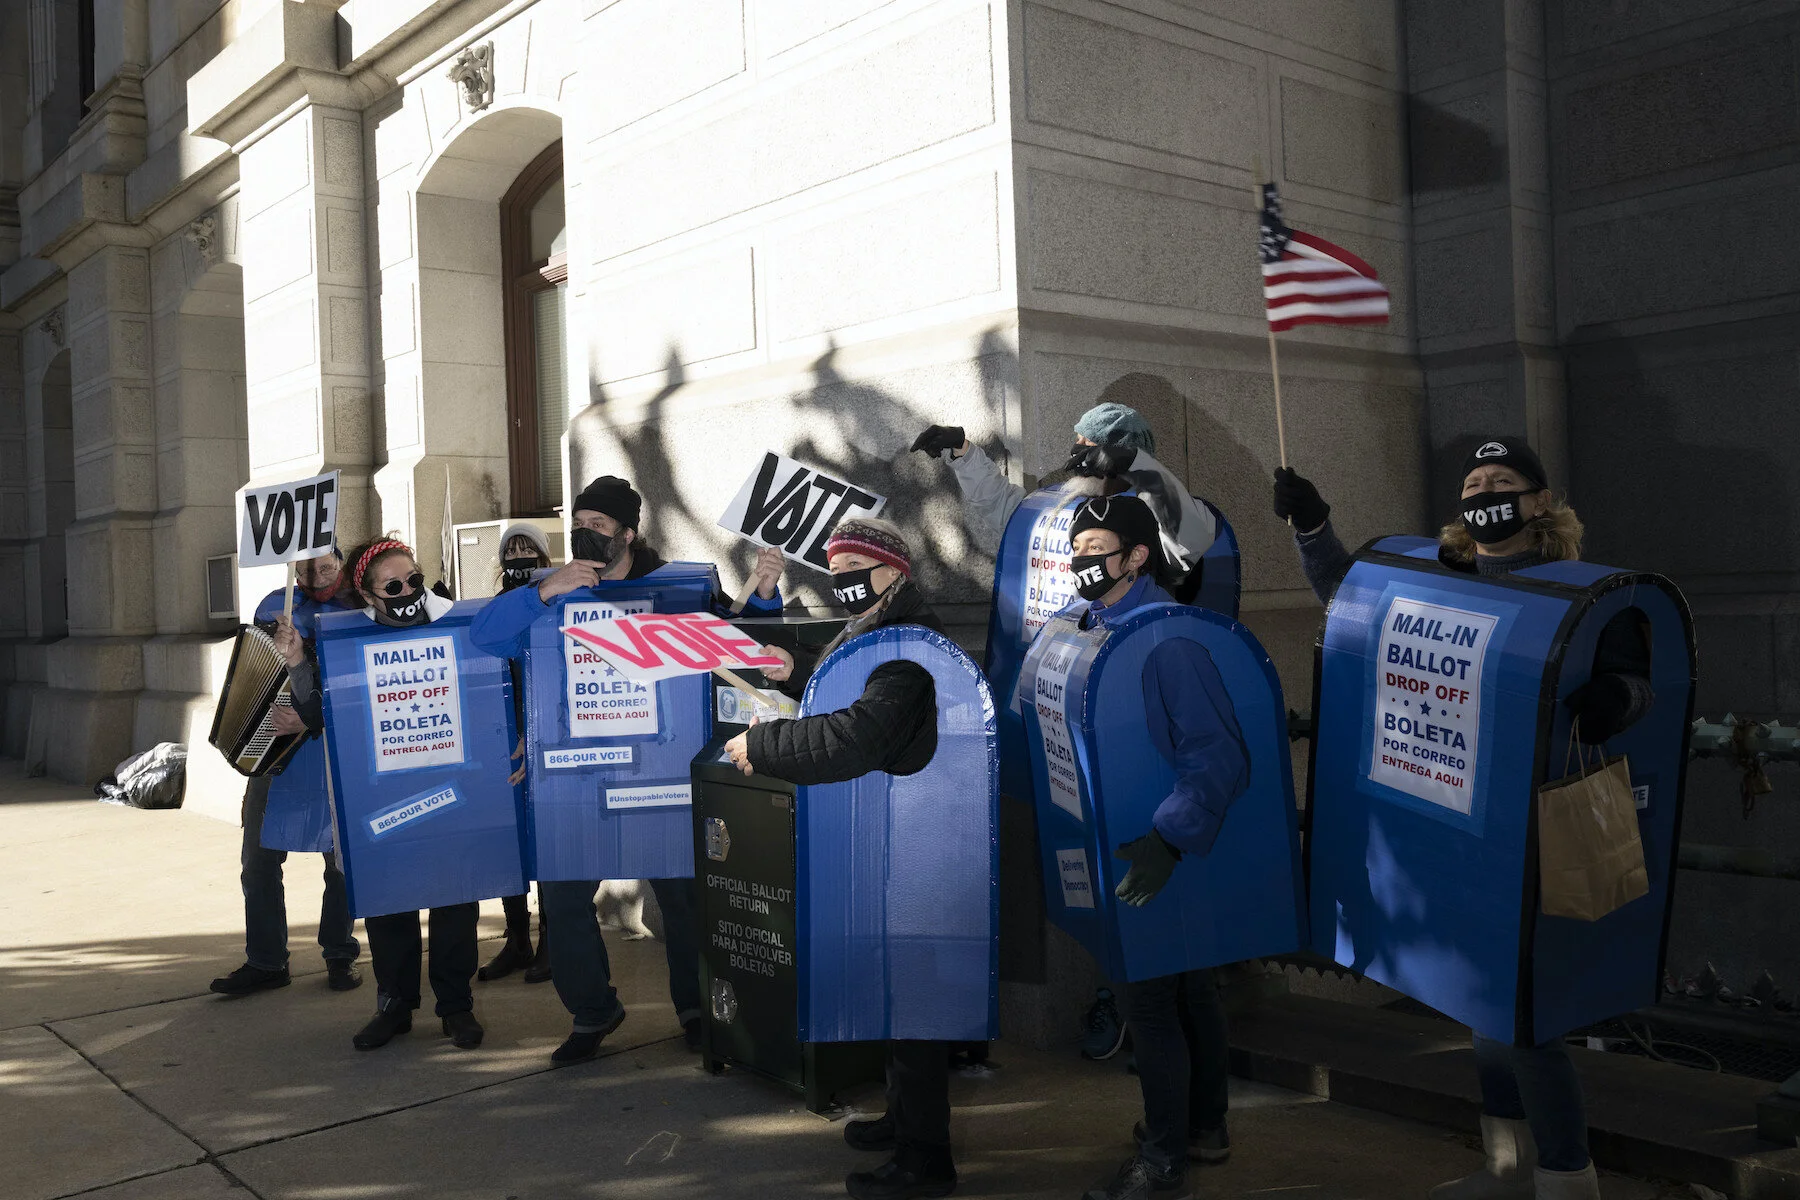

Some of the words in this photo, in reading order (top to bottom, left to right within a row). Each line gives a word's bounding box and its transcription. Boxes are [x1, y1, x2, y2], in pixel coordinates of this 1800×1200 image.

[245, 478, 335, 556] VOTE
[740, 452, 878, 569] VOTE
[1463, 503, 1514, 527] VOTE
[1032, 536, 1072, 556] BLLO
[1059, 562, 1071, 573] OF
[1073, 564, 1104, 590] OTE
[564, 613, 785, 669] VOTE
[1392, 612, 1479, 648] MAIL-IN
[373, 645, 446, 666] MAIL-IN
[573, 653, 603, 664] DRO
[1041, 652, 1072, 675] MAIL-IN
[1387, 643, 1471, 680] BALLOT
[375, 666, 448, 688] BALLOT
[575, 681, 647, 695] BOLETA
[1385, 672, 1430, 695] DROP
[1435, 685, 1470, 704] OFF
[377, 689, 418, 703] DROP
[422, 686, 450, 698] OFF
[1037, 677, 1063, 704] BALLOT
[576, 700, 598, 709] POR
[601, 697, 648, 708] CORREO
[1038, 702, 1051, 718] DROP
[1051, 710, 1063, 725] OFF
[380, 713, 452, 732] BOLETA
[577, 711, 622, 720] ENTREGA
[624, 711, 649, 719] AQUI
[381, 735, 405, 745] POR
[408, 729, 454, 743] CORREO
[1384, 712, 1467, 751] BOLETA
[383, 745, 429, 756] ENTREGA
[431, 741, 455, 751] AQUI
[549, 752, 597, 764] 866-OUR
[600, 750, 630, 761] VOTE
[1045, 737, 1073, 765] BOLETA
[1383, 737, 1409, 754] POR
[1412, 745, 1466, 770] CORREO
[1382, 754, 1432, 779] ENTREGA
[1435, 771, 1464, 788] AQUI
[377, 804, 423, 830] 866-OUR
[423, 789, 453, 808] VOTE
[609, 792, 690, 803] #UnstoppableVoters
[706, 874, 750, 895] OFFICIAL
[751, 882, 792, 904] BALLOT
[729, 894, 769, 915] RETURN
[718, 919, 743, 938] SITIO
[745, 925, 785, 948] OFICIAL
[712, 933, 738, 952] PARA
[739, 940, 792, 966] DEVOLVER
[729, 953, 775, 978] BOLETAS
